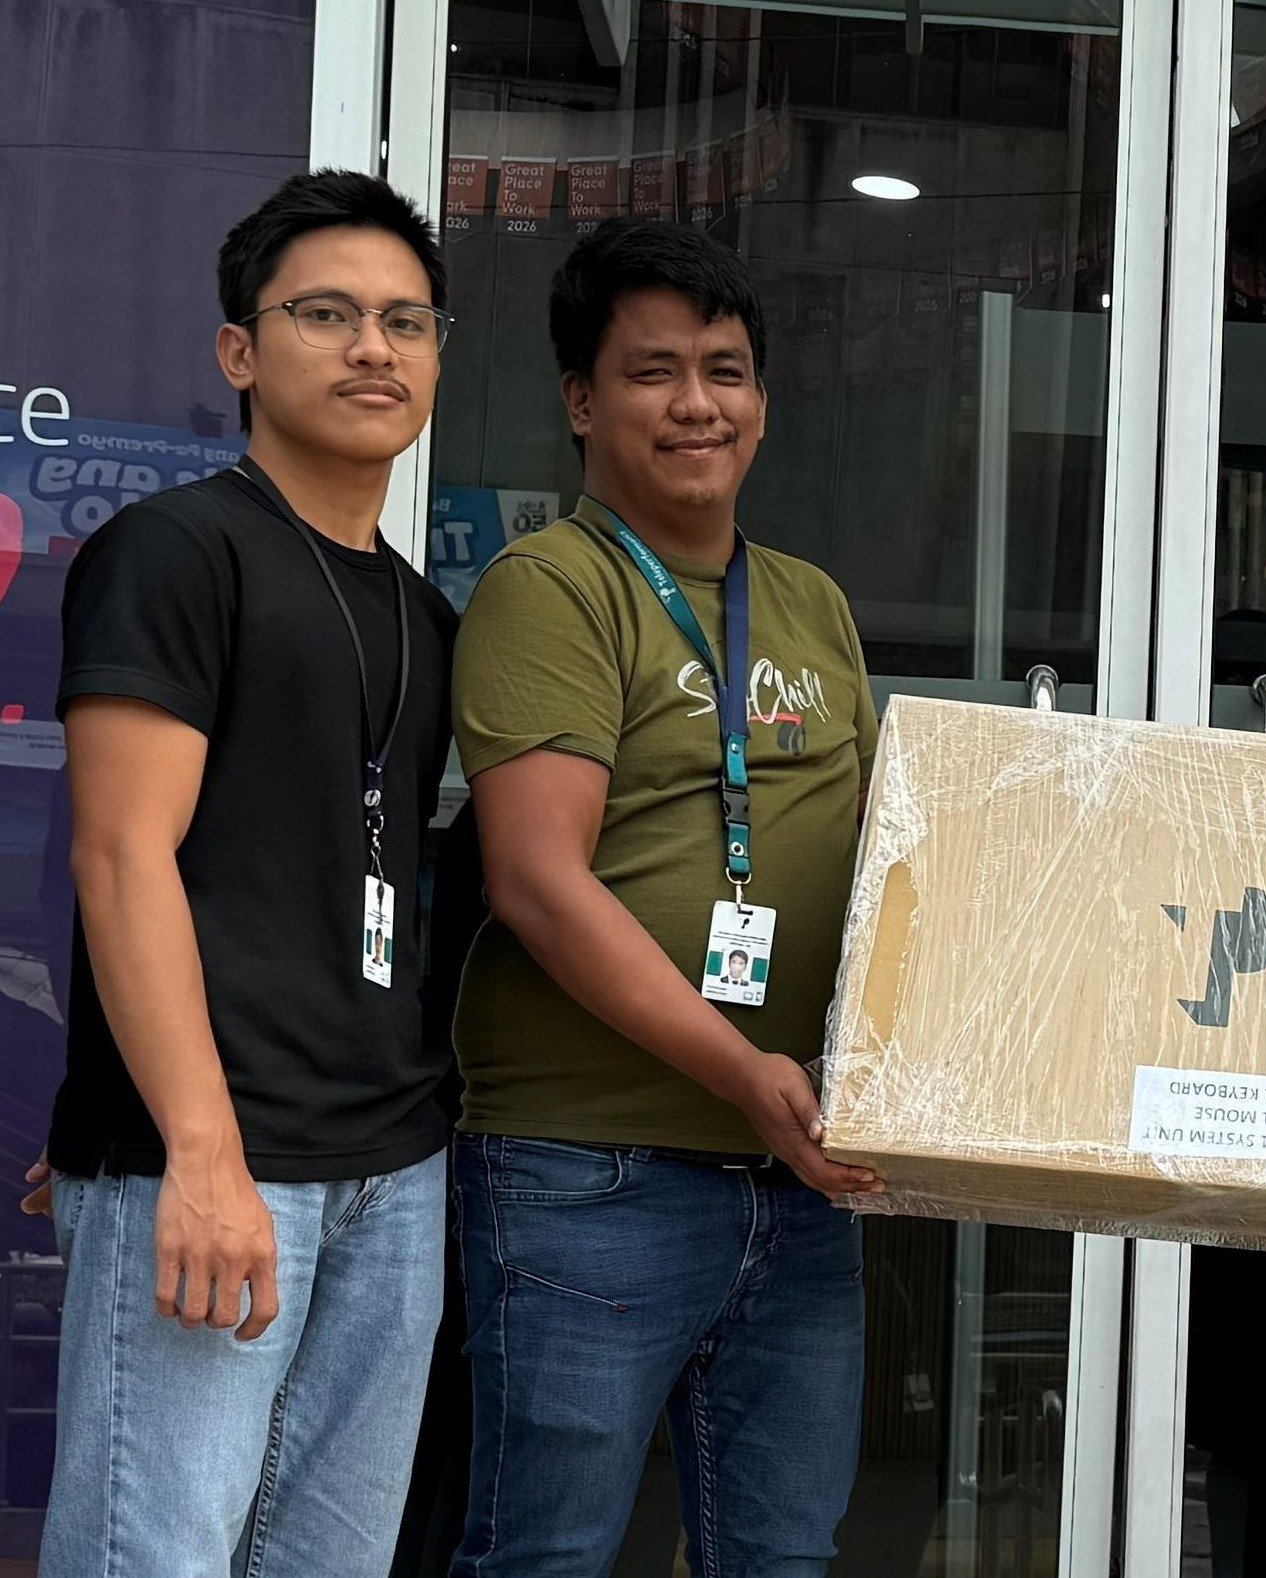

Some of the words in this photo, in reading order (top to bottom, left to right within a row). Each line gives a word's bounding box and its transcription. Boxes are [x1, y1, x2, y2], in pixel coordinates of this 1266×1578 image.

[505, 163, 544, 176] Great
[571, 163, 607, 176] Great
[504, 176, 542, 189] Place
[571, 177, 606, 190] Place
[502, 189, 518, 201] To
[571, 191, 584, 203] To
[502, 201, 536, 215] Work
[571, 205, 601, 216] Work
[445, 216, 470, 229] 026
[507, 220, 537, 232] 2026
[750, 658, 831, 724] Chill
[1169, 1081, 1259, 1101] KEYBOARD
[1195, 1106, 1257, 1124] MOUSE
[1190, 1129, 1255, 1148] SYSTEM
